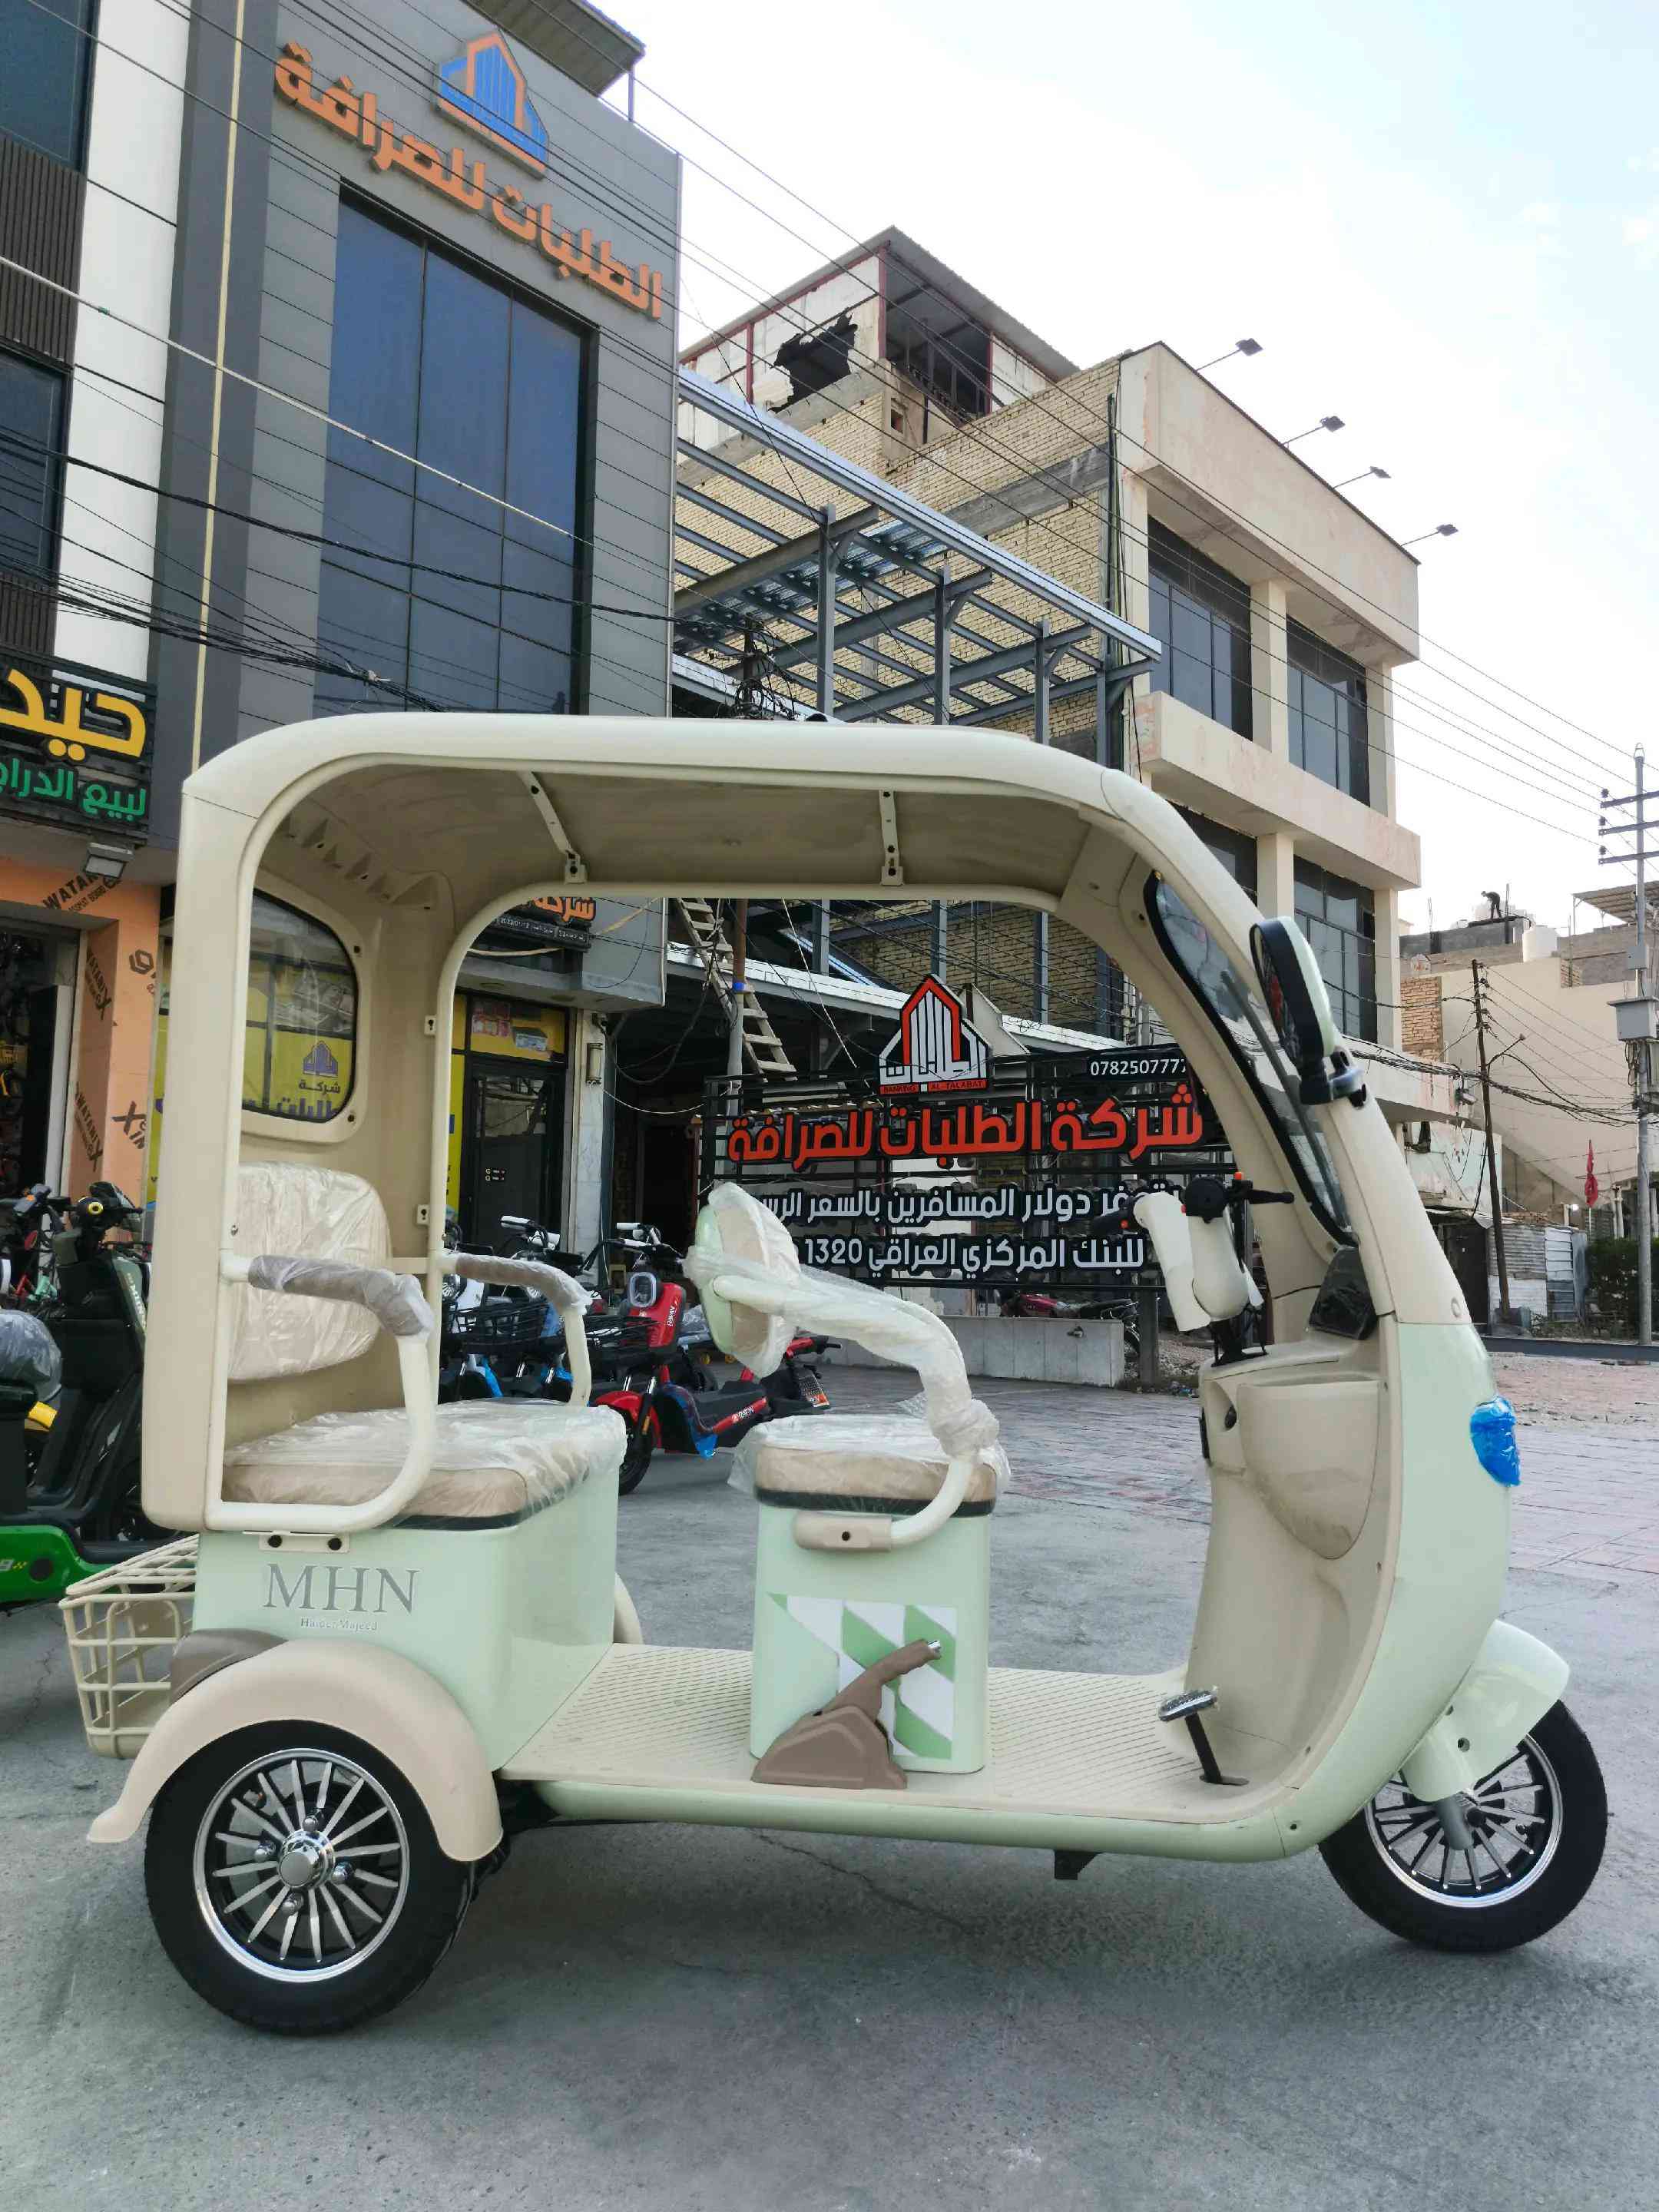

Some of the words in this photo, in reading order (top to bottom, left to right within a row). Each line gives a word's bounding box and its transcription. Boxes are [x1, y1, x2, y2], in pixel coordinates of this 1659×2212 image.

[275, 41, 485, 210] للصرافة
[492, 184, 663, 320] الطلبات
[0, 757, 75, 800] الدرا
[82, 783, 147, 821] لبيع
[299, 1079, 340, 1096] شركة
[727, 1108, 873, 1172] للصرافة
[880, 1101, 1042, 1167] الطلبات
[1051, 1083, 1204, 1161] شركة
[763, 1191, 802, 1223] الرس
[807, 1190, 880, 1224] بالسعر
[888, 1188, 1015, 1223] المسافرين
[1022, 1187, 1091, 1223] دولار
[805, 1237, 863, 1264] 1320
[869, 1238, 955, 1278] العراقي
[962, 1238, 1065, 1280] المركزي
[1072, 1238, 1144, 1275] للبنك
[263, 1563, 422, 1614] MHN
